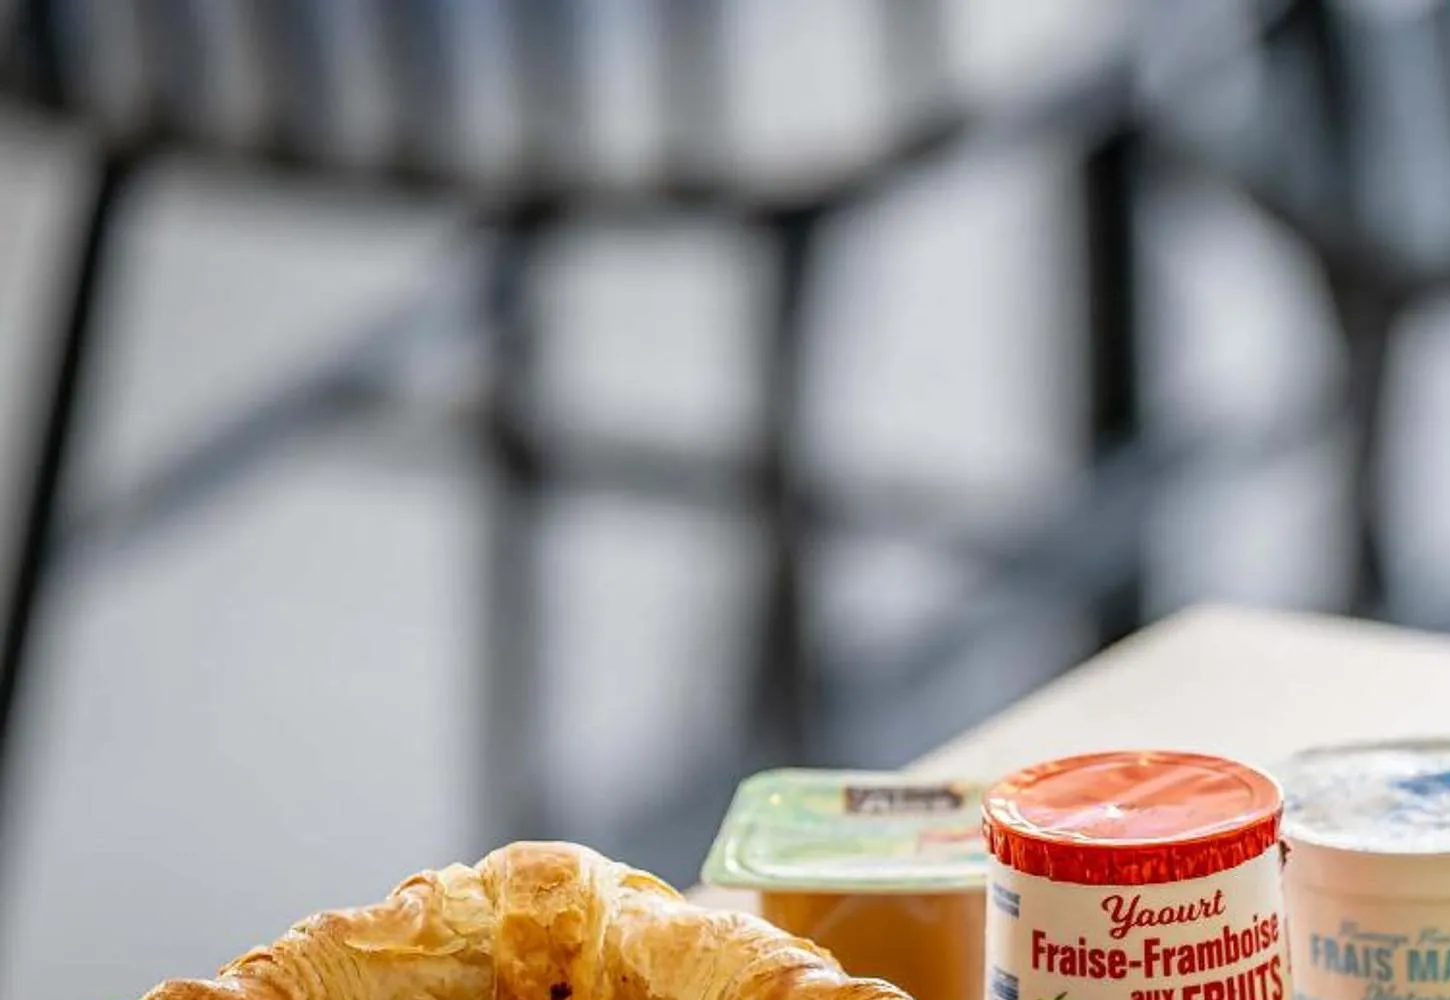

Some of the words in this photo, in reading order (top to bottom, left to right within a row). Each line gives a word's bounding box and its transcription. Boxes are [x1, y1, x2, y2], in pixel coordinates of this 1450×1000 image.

[1100, 889, 1226, 939] Yaourt
[1031, 912, 1280, 980] Fraise-Framboise
[1309, 933, 1394, 982] FRAIS
